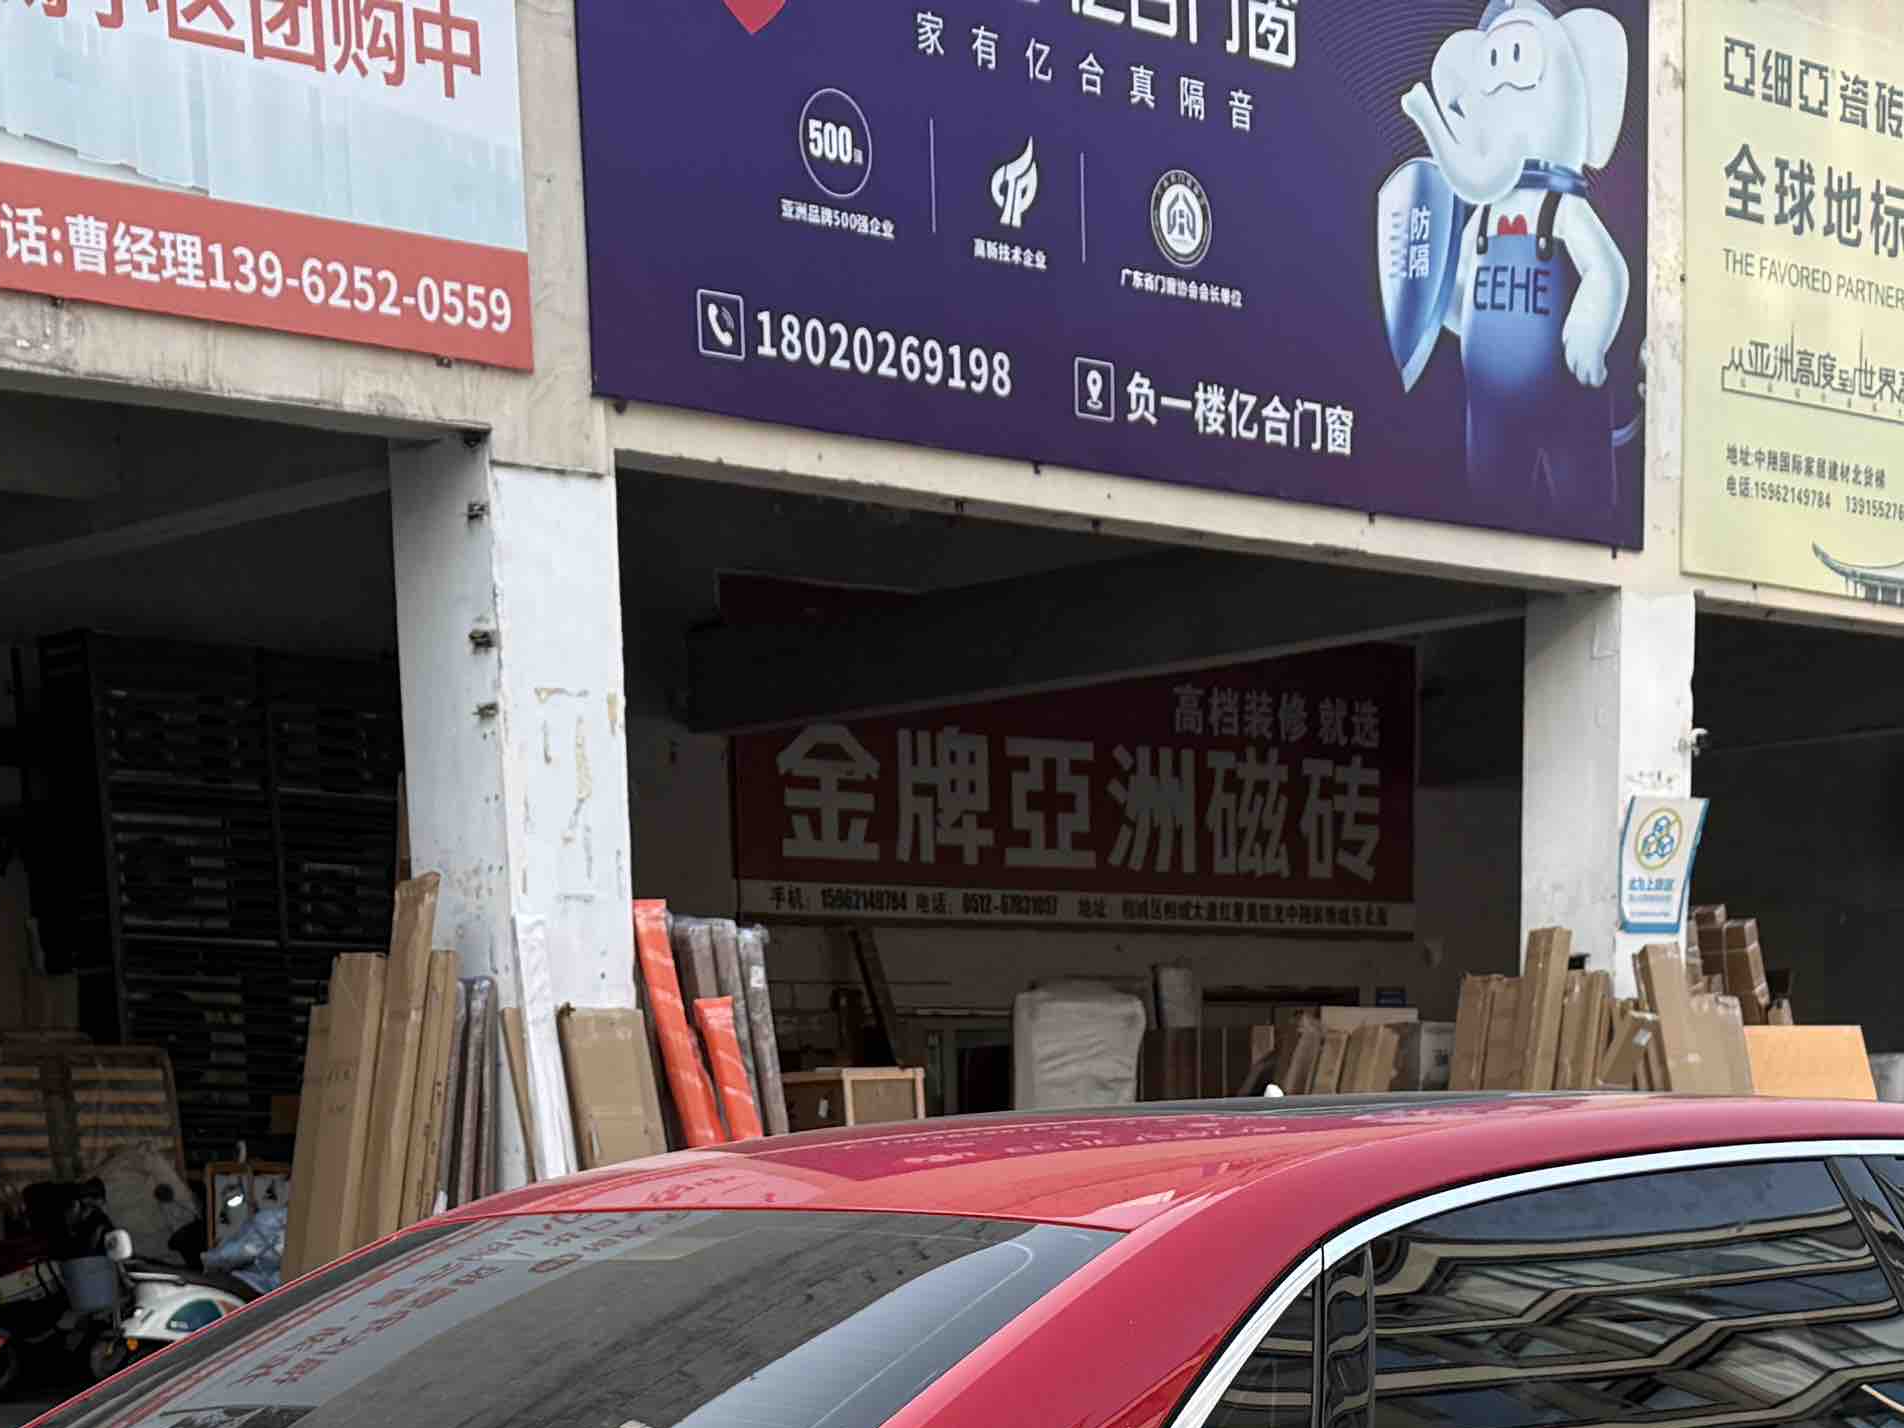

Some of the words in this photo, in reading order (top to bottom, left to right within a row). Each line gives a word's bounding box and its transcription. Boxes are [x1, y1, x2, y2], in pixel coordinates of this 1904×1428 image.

[916, 11, 1254, 132] 家有亿合真隔音
[1473, 264, 1551, 316] EEHE
[1723, 247, 1756, 277] THE
[1759, 255, 1832, 294] FAVORED
[756, 309, 1013, 398] 18020269198
[1125, 371, 1354, 457] 负一楼亿合门窗
[1173, 684, 1308, 743] 高档装修
